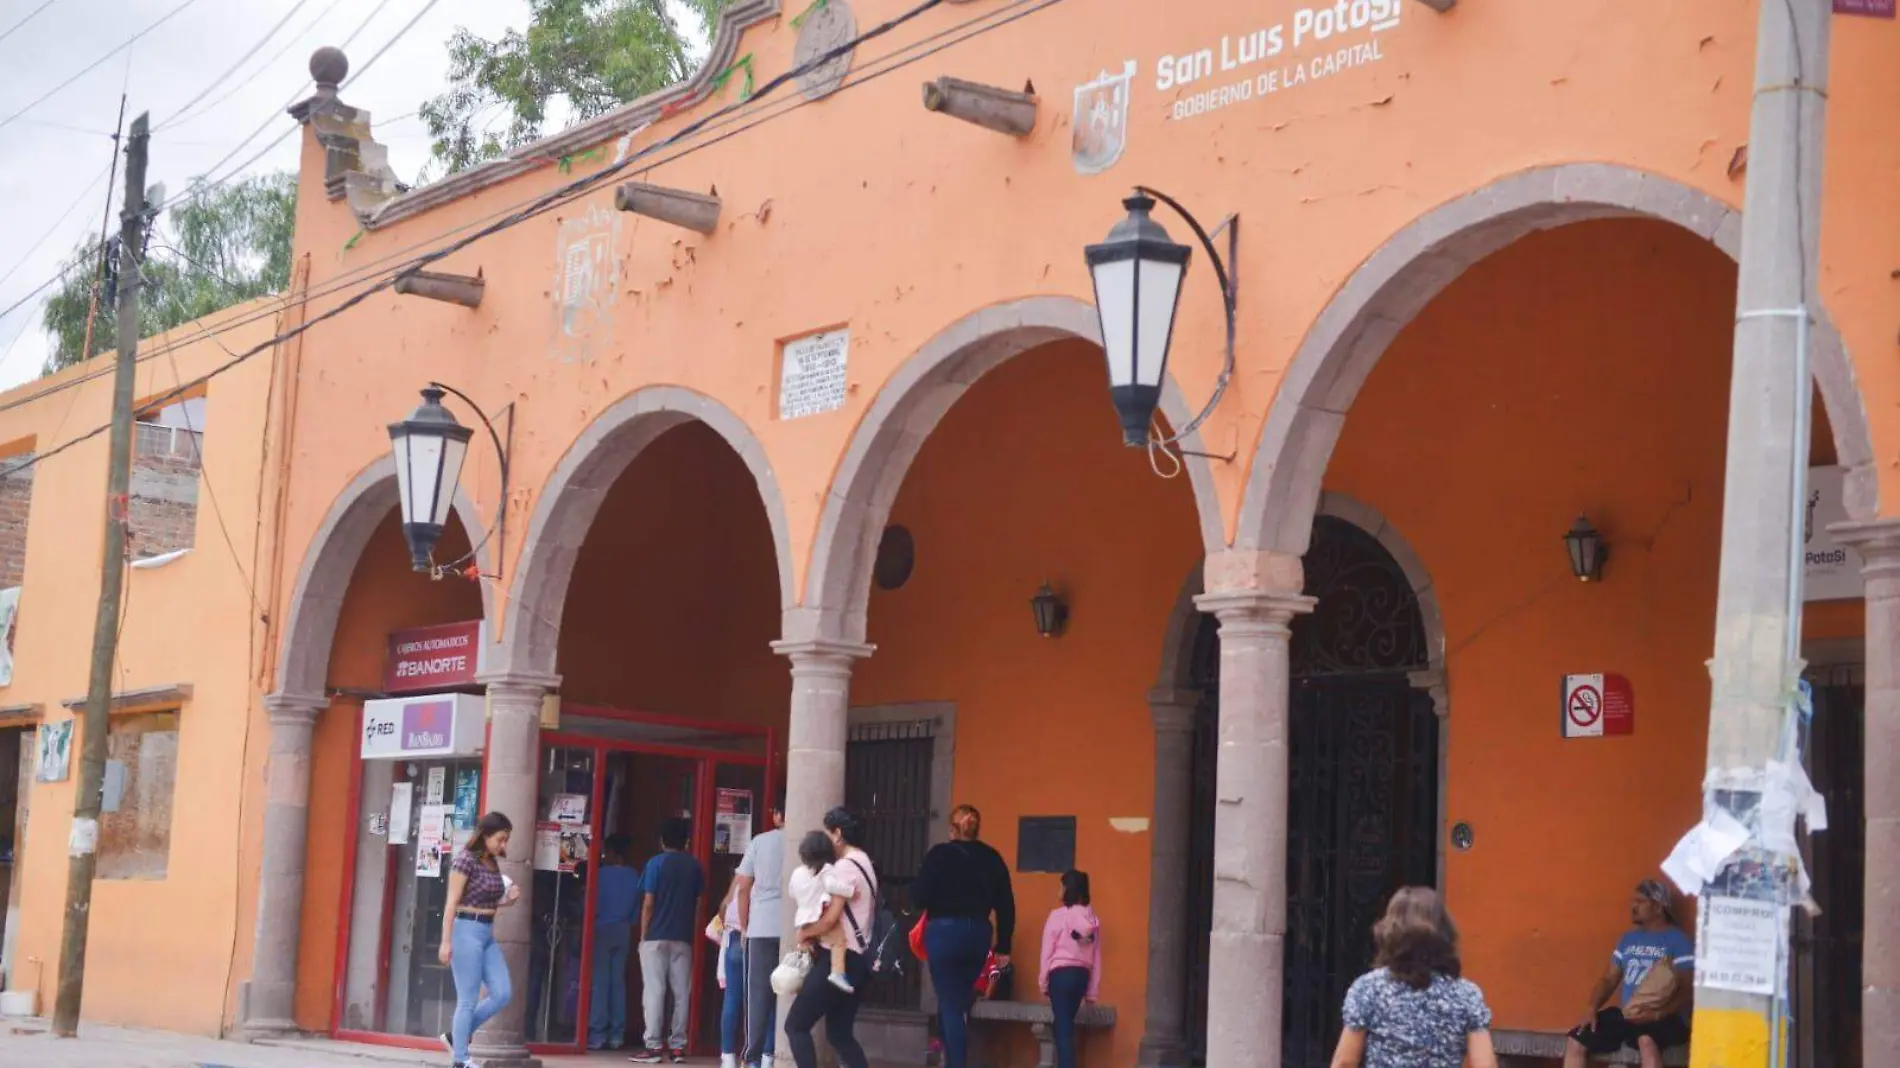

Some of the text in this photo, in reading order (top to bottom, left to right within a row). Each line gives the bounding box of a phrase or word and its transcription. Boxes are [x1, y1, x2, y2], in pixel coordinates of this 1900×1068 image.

[1156, 48, 1212, 90] San
[1221, 25, 1283, 70] Luis
[1173, 40, 1382, 120] GOBIERNO DE LA CAPITAL
[407, 656, 466, 676] BANORTE
[377, 722, 394, 735] RED
